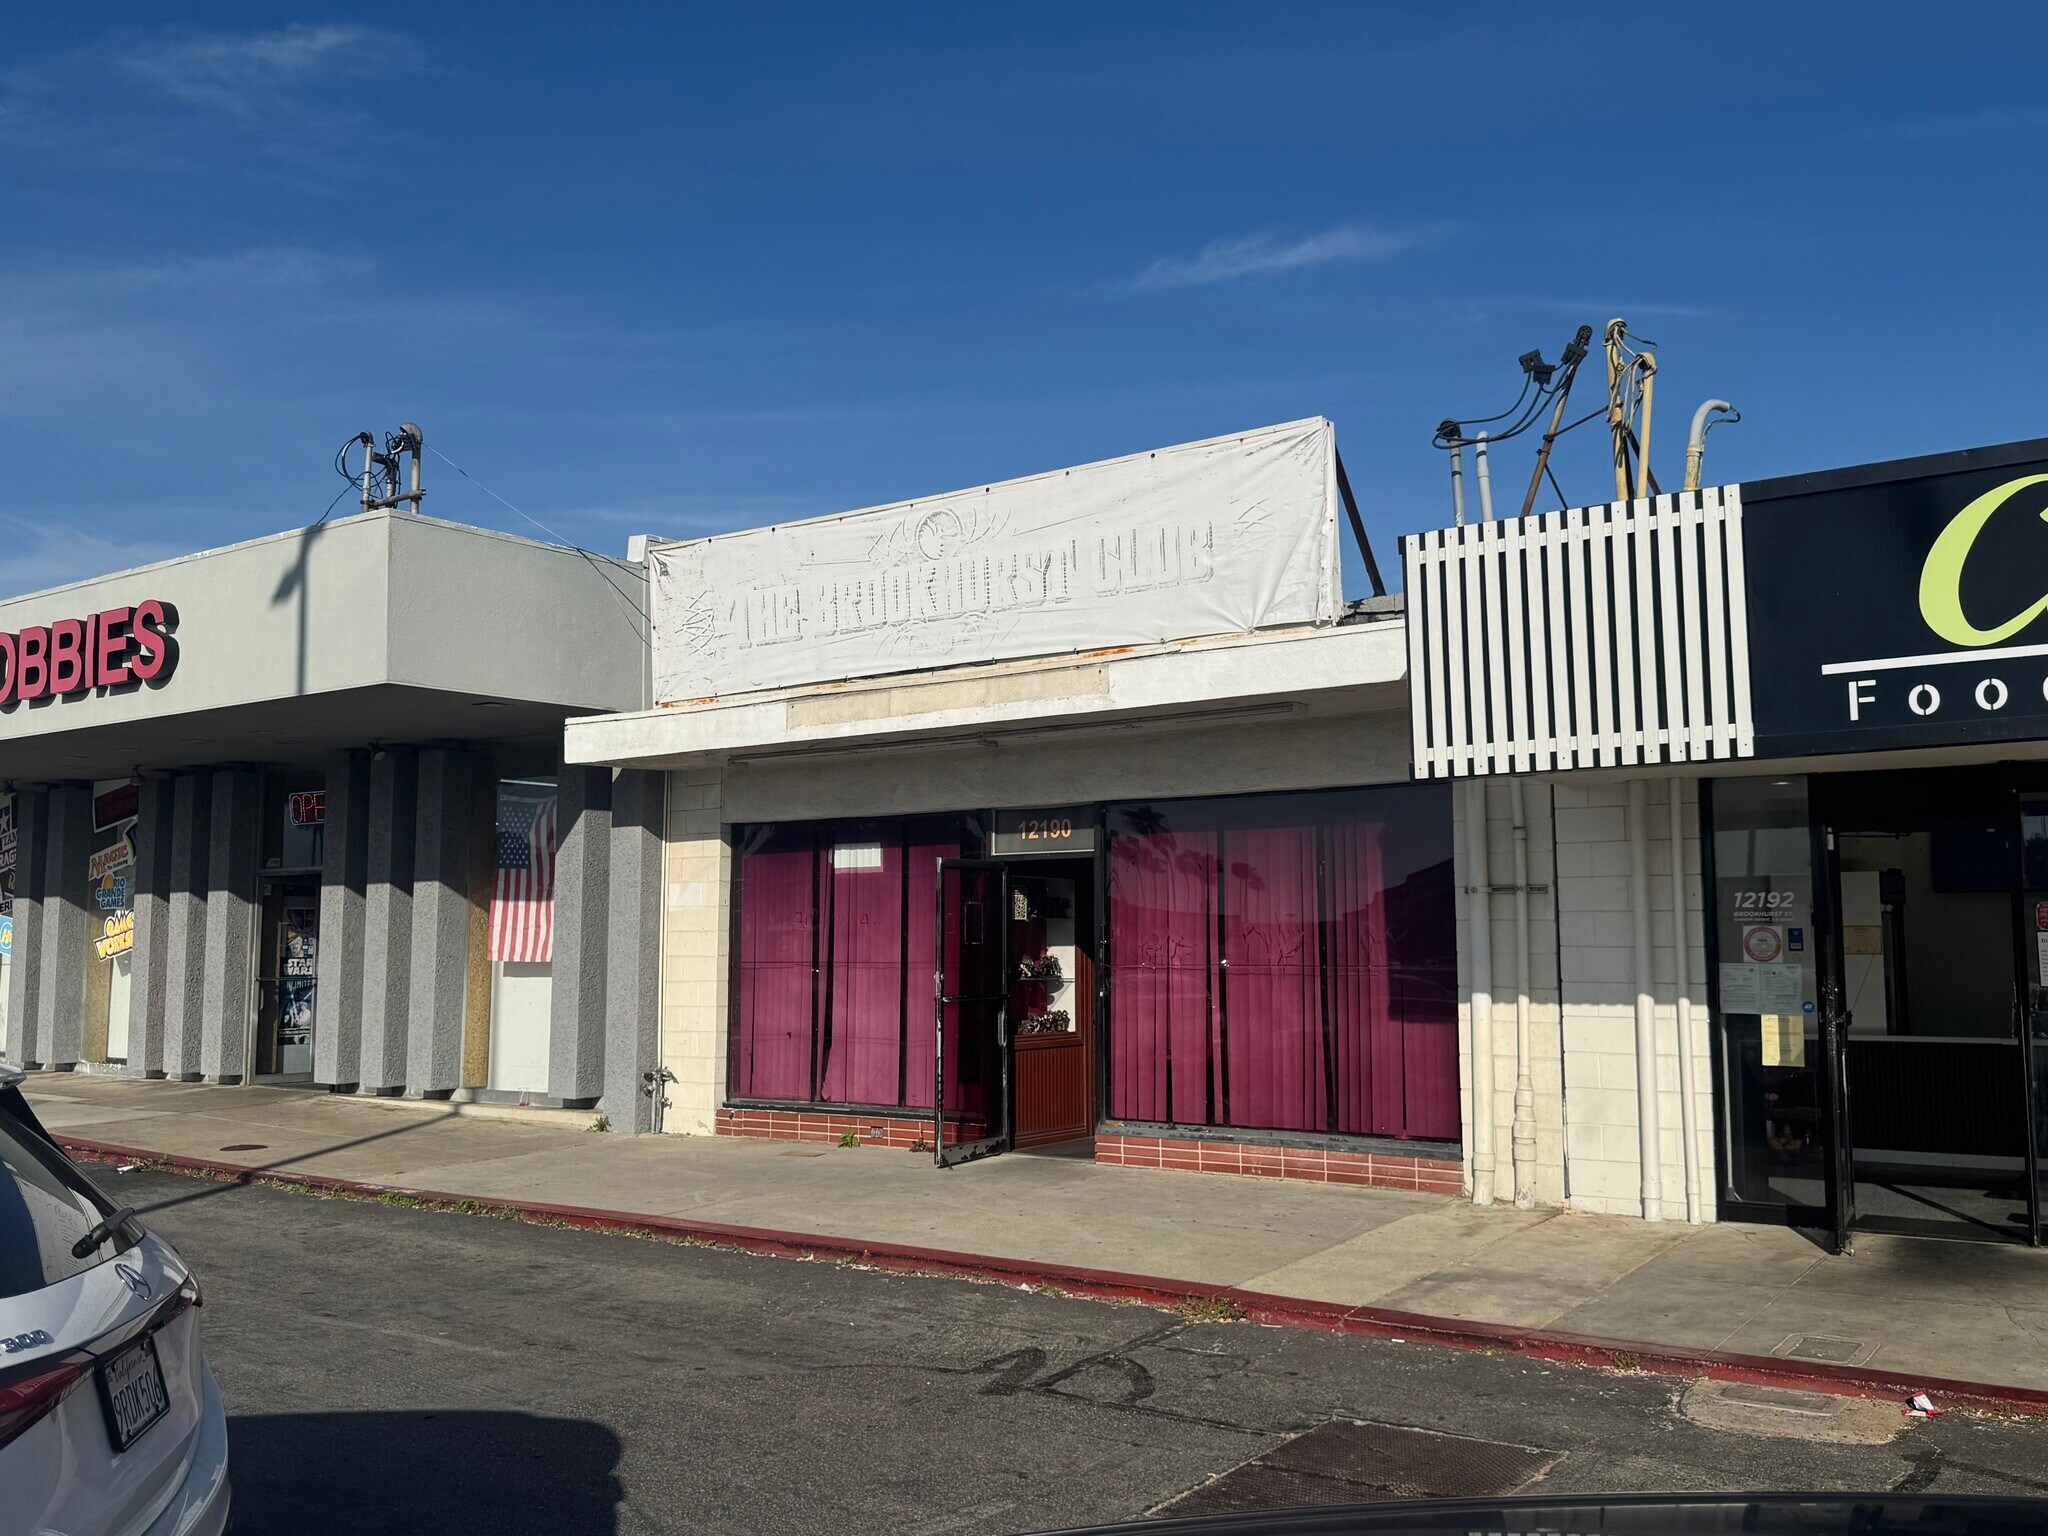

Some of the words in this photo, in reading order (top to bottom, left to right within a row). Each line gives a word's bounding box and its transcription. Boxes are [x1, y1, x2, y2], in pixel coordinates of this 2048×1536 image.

[1092, 520, 1214, 598] CLUB
[1848, 676, 2048, 721] FOO
[1018, 818, 1072, 841] 12190
[90, 844, 129, 879] MAGIC
[114, 878, 125, 888] RIO
[96, 887, 125, 899] GRANDE
[1734, 891, 1796, 908] 12192
[100, 898, 125, 909] GAMES
[1733, 910, 1783, 918] BROOKHURST
[287, 958, 313, 967] STAR
[112, 1364, 163, 1436] 9RDK506
